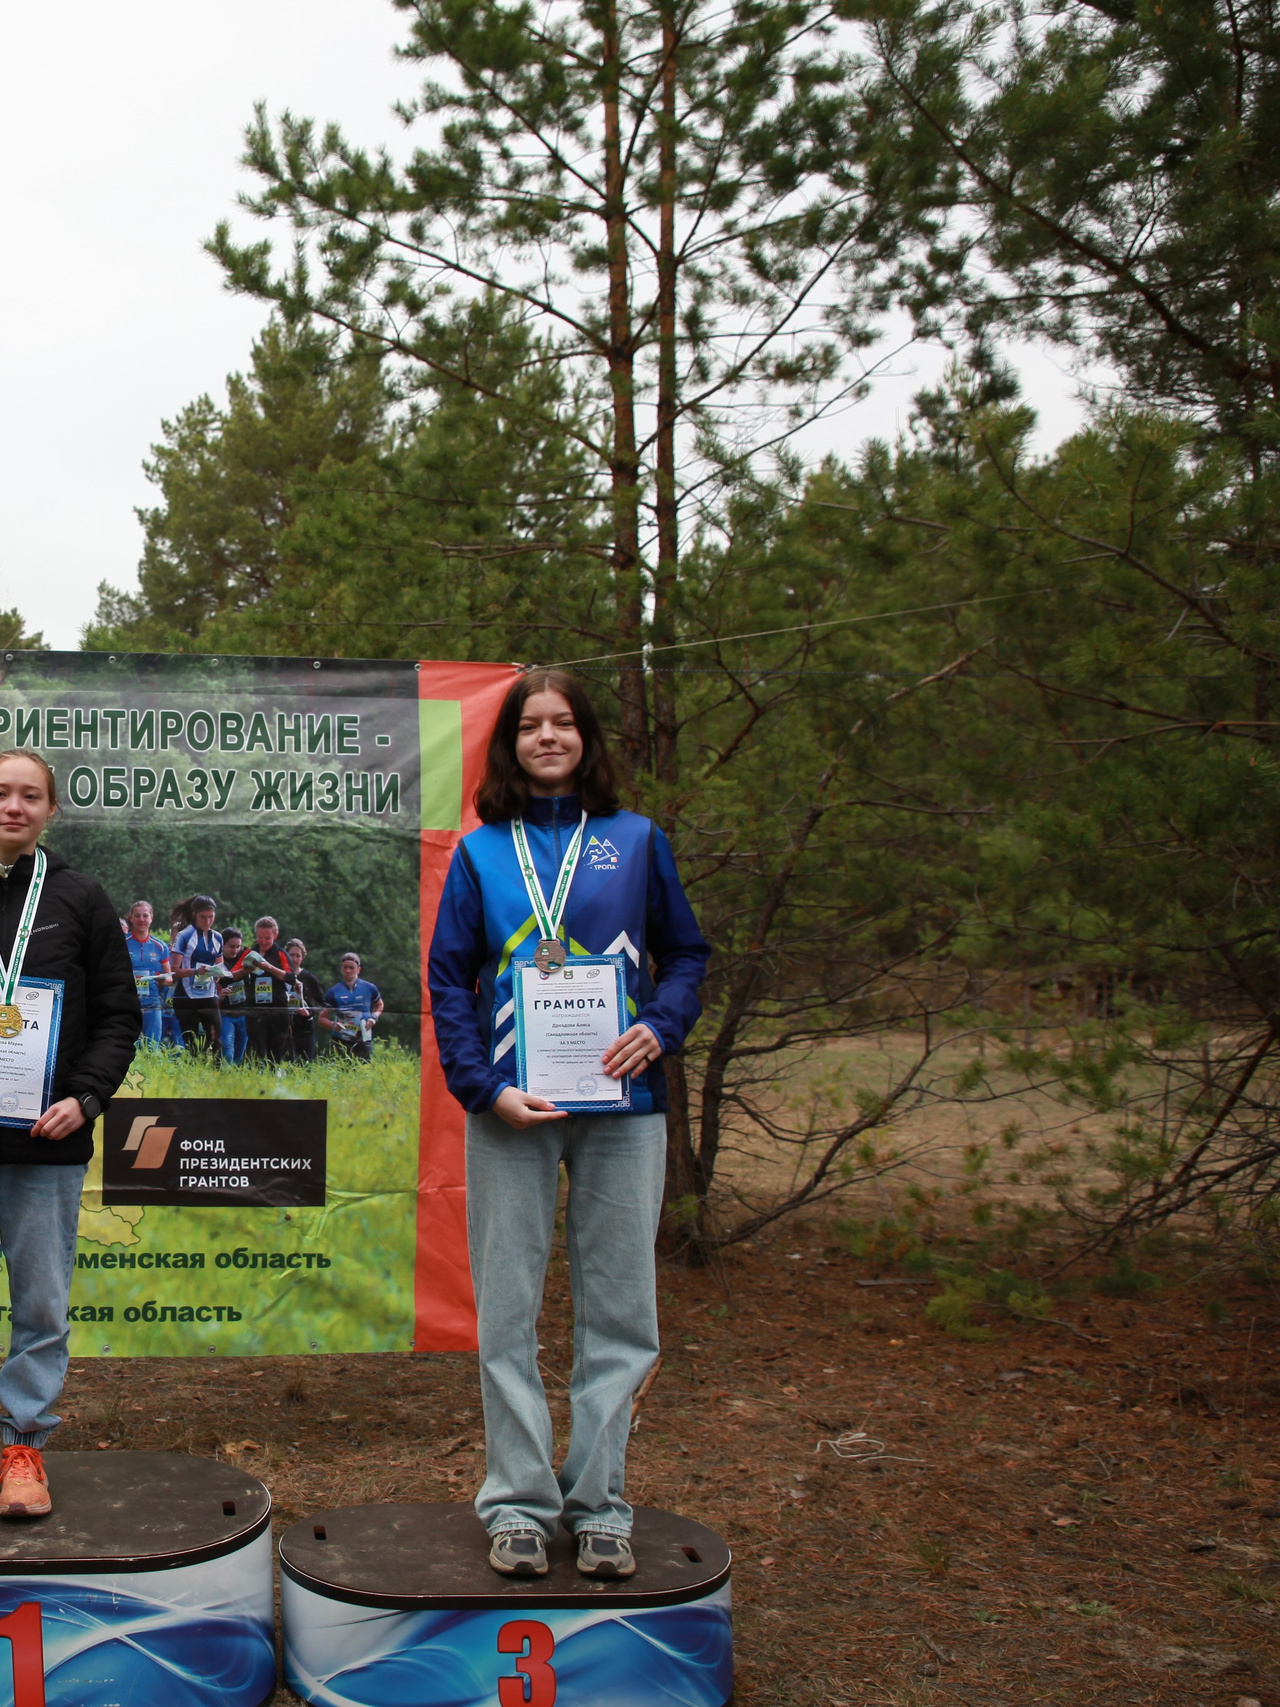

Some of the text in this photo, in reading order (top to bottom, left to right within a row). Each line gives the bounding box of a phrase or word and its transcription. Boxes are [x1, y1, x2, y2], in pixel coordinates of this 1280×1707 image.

[68, 766, 236, 810] ОБРАЗУ
[250, 770, 400, 814] ЖИЗНИ
[534, 998, 606, 1010] ГРАМОТА
[180, 1140, 226, 1154] ФОНД
[180, 1158, 312, 1170] ПРЕЗИДЕНТСКИХ
[180, 1176, 250, 1188] ГРАНТОВ
[74, 1247, 332, 1270] менская область
[124, 1300, 243, 1323] область
[496, 1619, 556, 1707] 3
